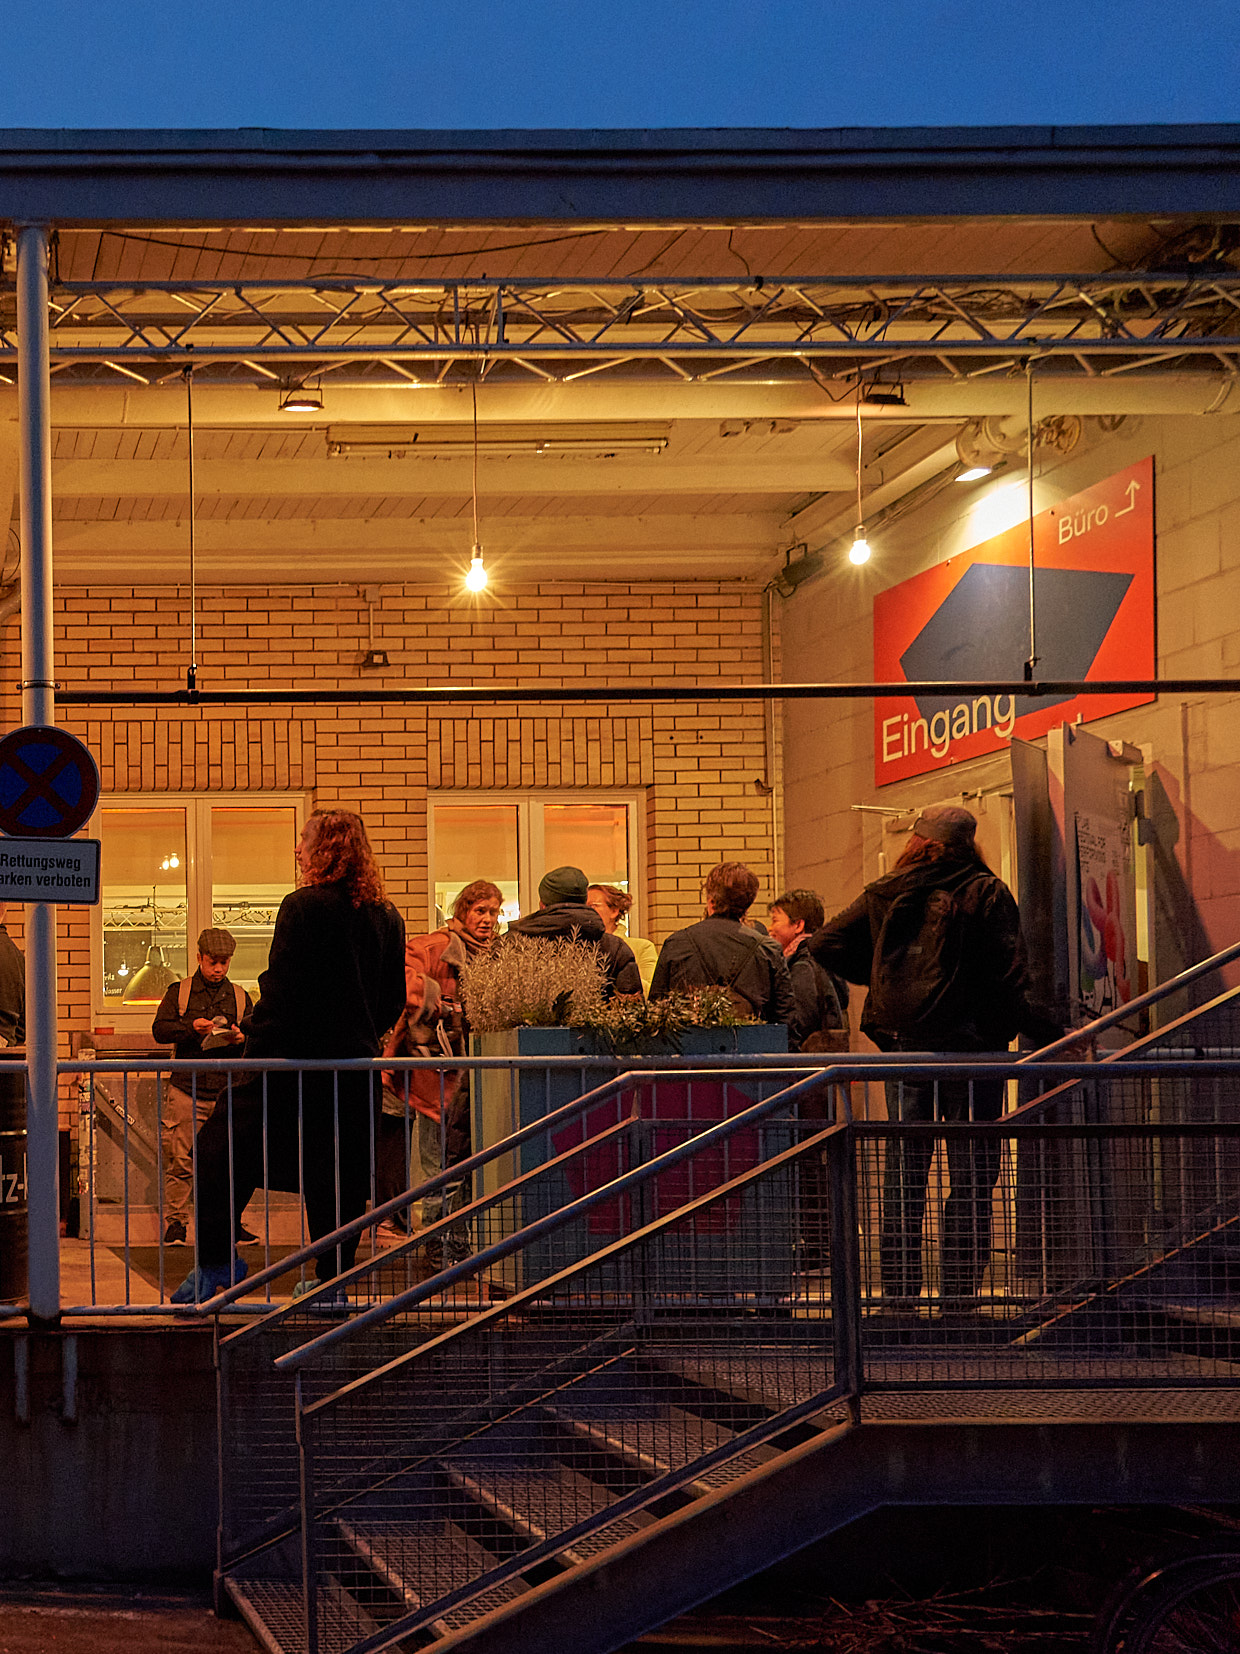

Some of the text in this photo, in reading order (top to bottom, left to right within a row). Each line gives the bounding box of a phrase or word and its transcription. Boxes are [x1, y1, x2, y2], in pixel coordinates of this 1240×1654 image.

[1058, 503, 1109, 545] Büro
[882, 694, 1015, 763] Eingang
[0, 853, 81, 872] Rettungsweg
[36, 874, 91, 887] verboten
